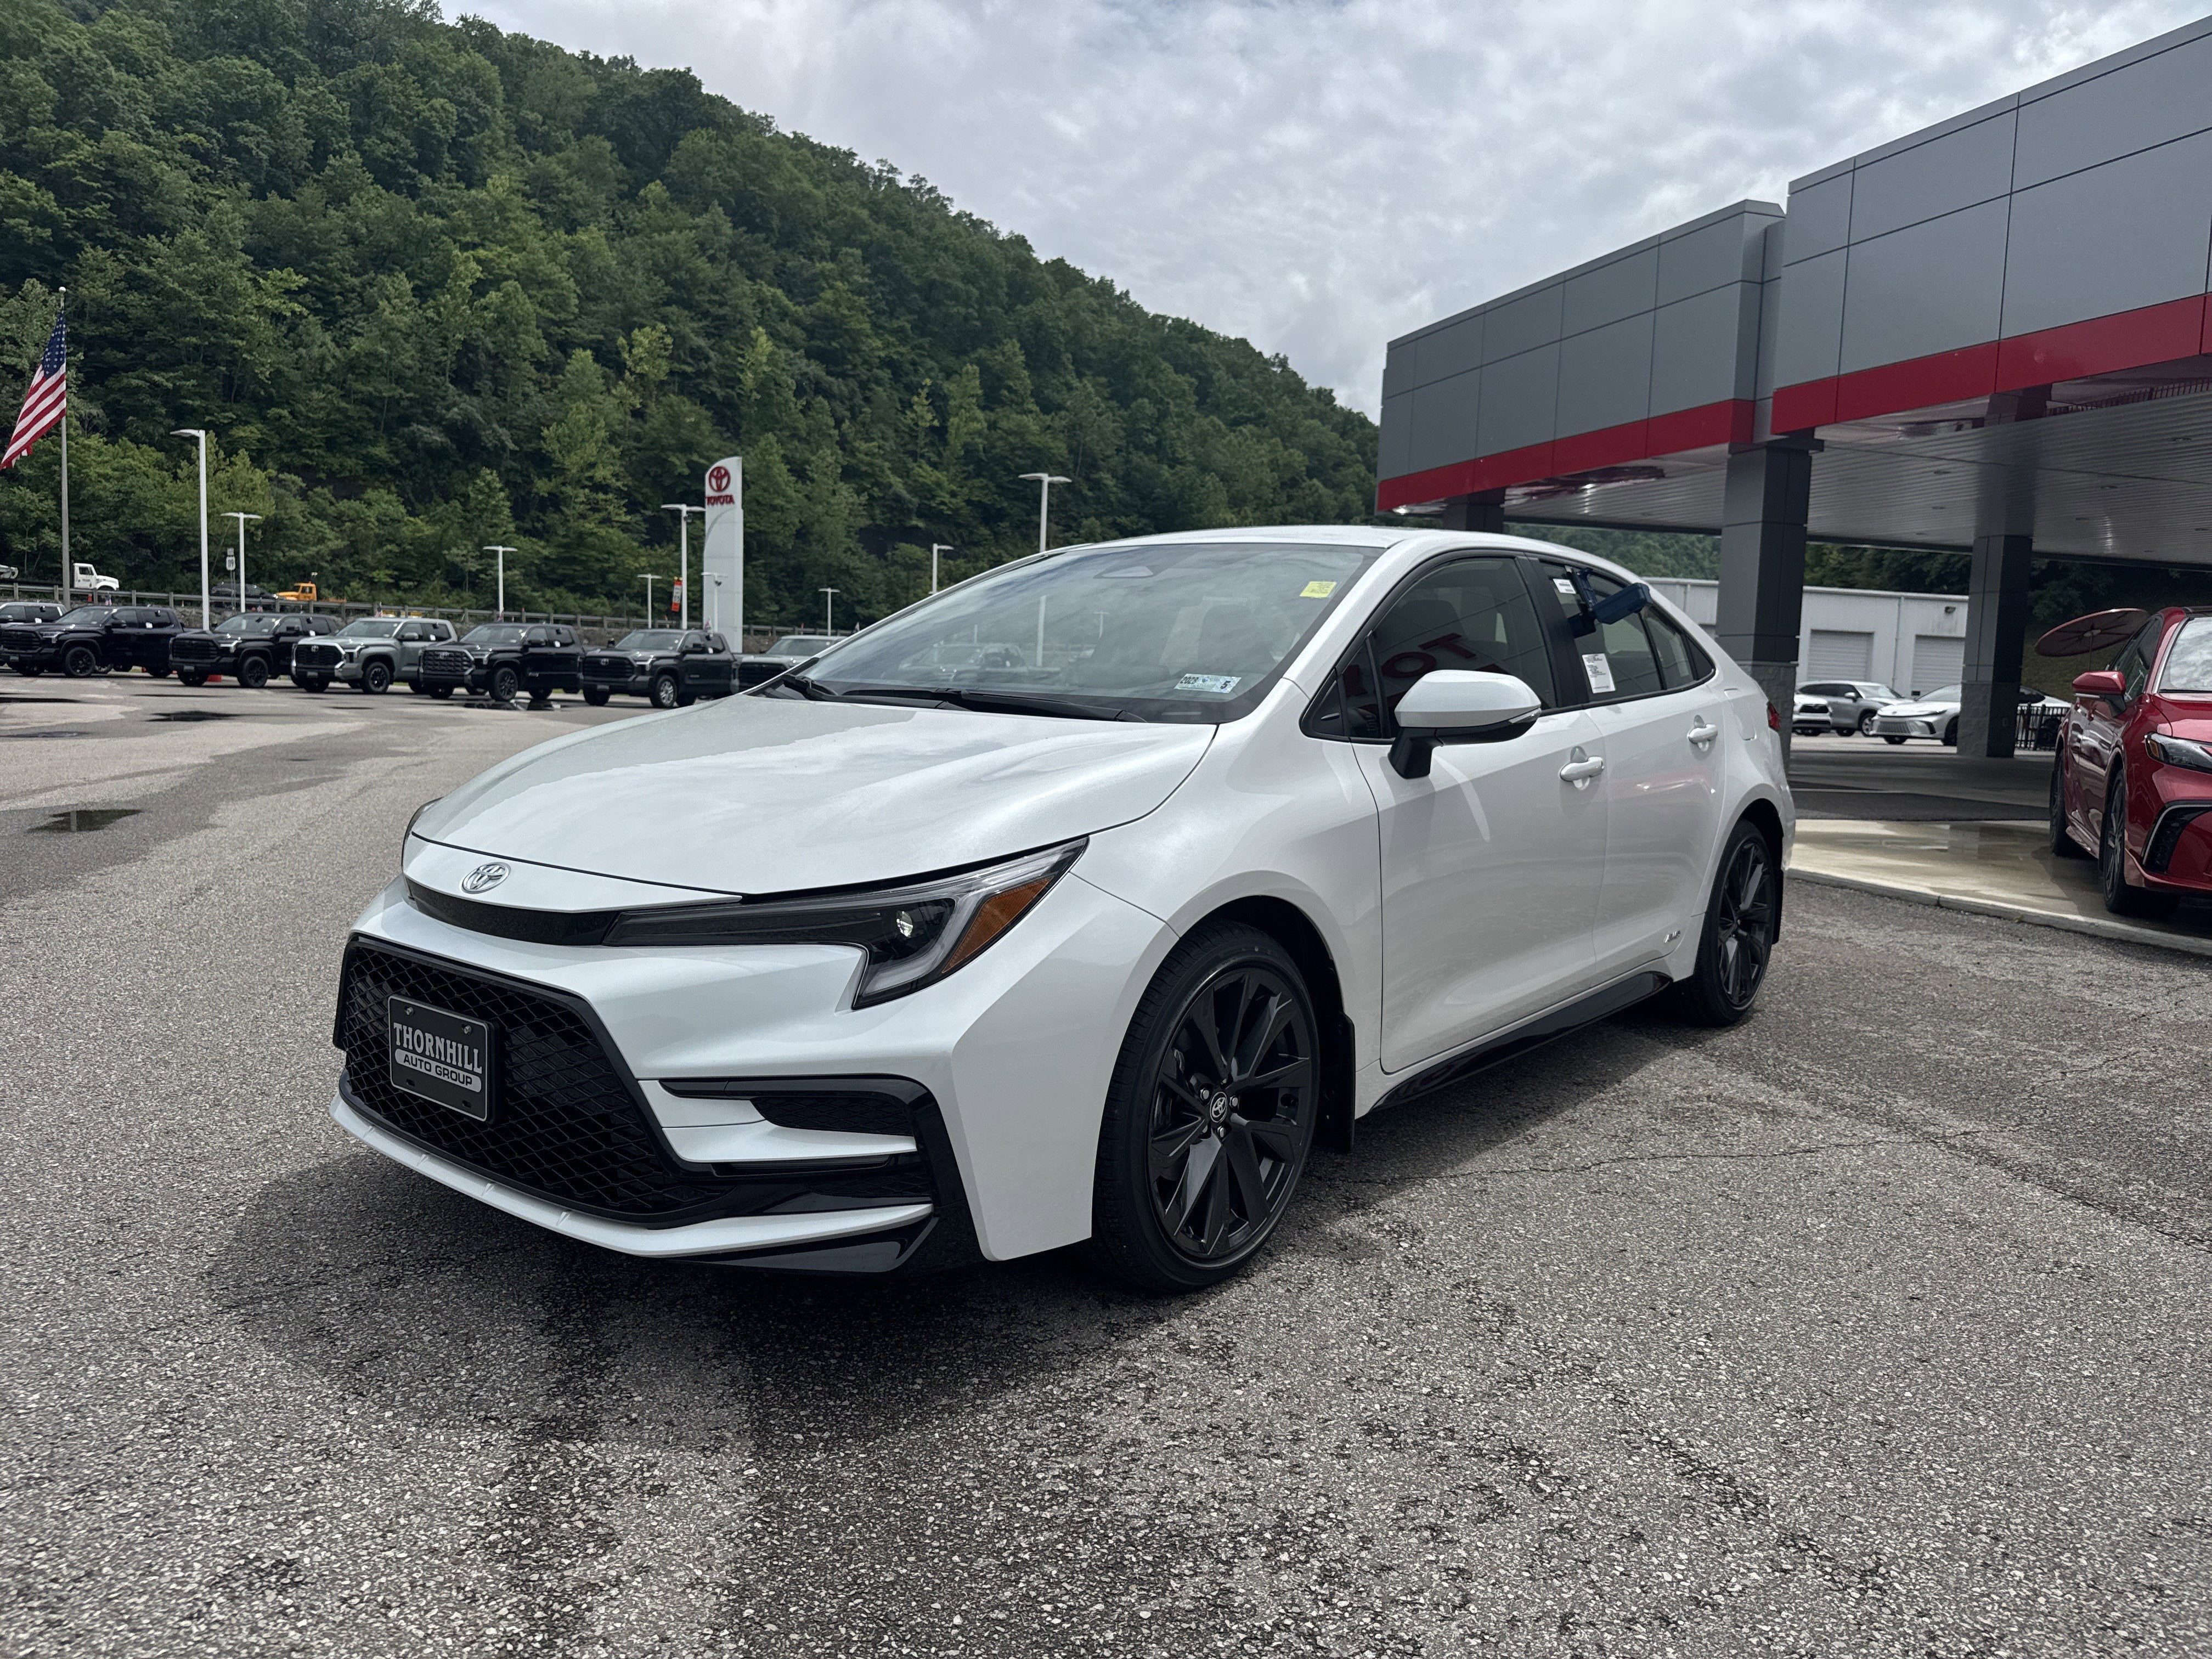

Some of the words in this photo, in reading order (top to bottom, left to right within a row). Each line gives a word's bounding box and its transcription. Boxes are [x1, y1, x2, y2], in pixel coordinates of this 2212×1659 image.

[705, 495, 735, 505] TOYOTA
[1220, 680, 1232, 689] 5
[393, 1022, 483, 1074] THORNHILL
[403, 1053, 432, 1073] AUTO
[435, 1064, 473, 1087] GROUP
